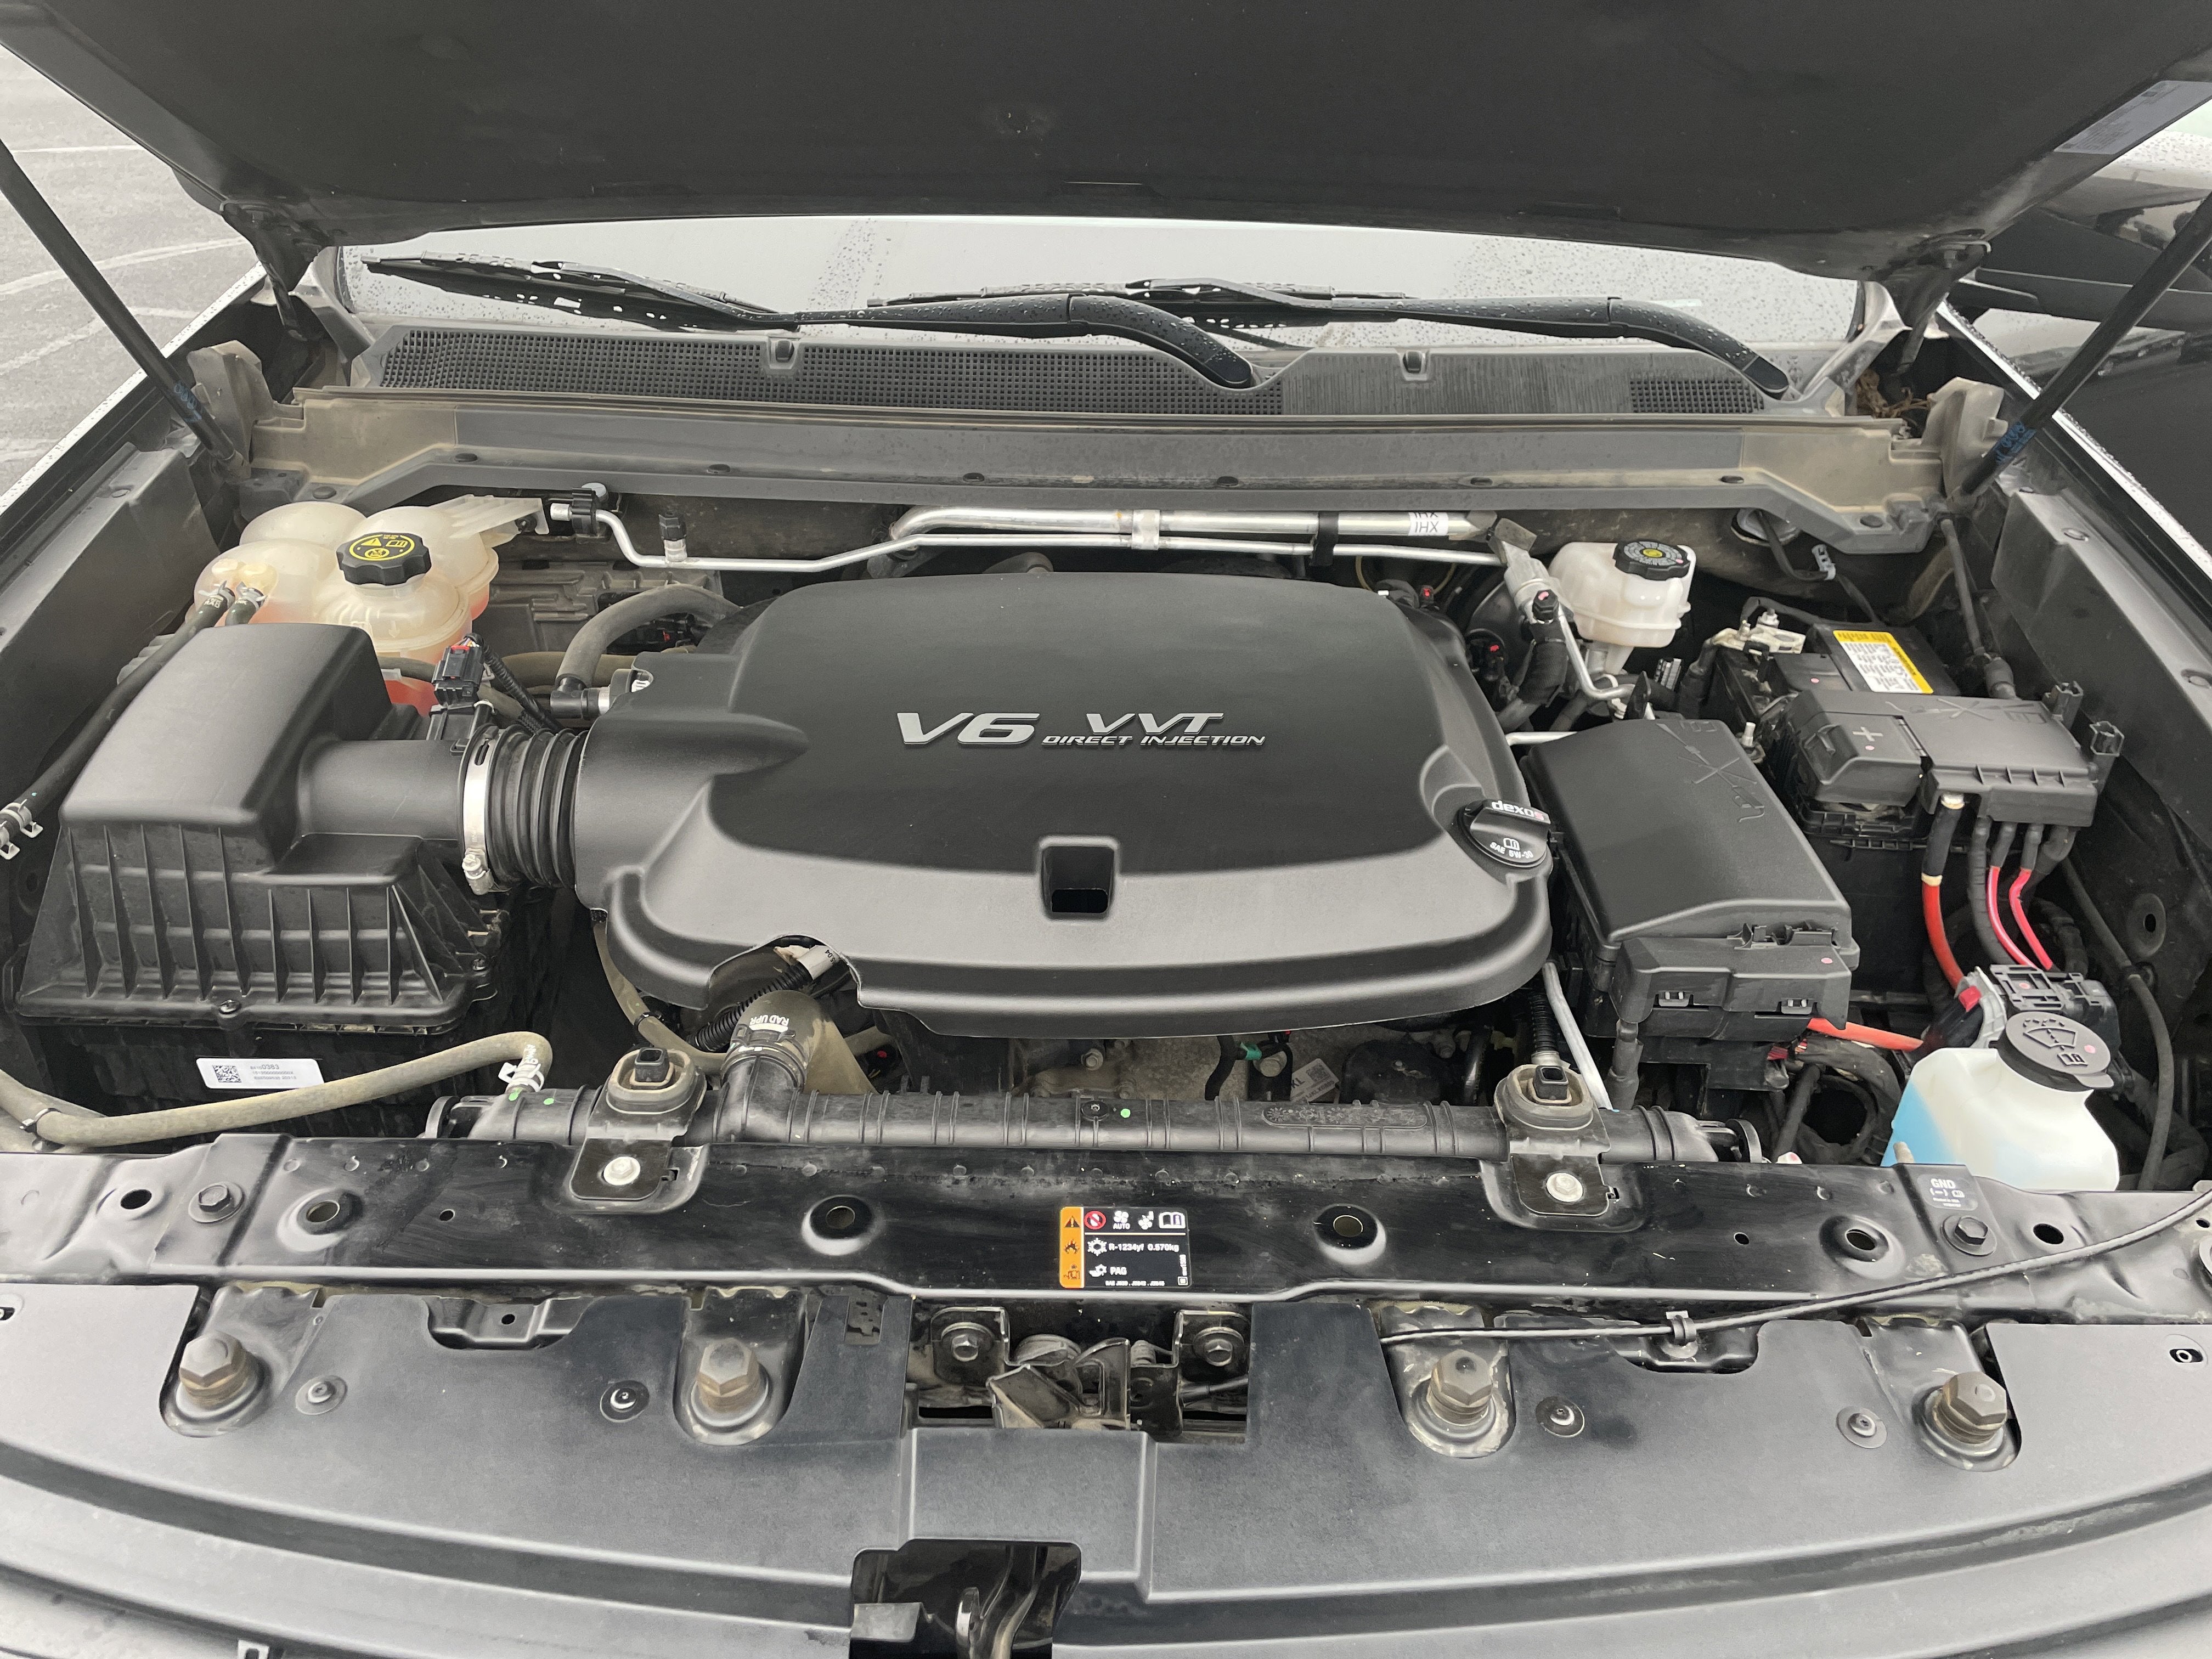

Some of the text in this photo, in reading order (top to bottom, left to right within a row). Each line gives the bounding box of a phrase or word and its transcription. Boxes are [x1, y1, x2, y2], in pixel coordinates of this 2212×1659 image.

[1415, 521, 1438, 533] IHX
[897, 713, 1224, 745] V6 VVT
[1042, 735, 1266, 746] DIRECT INJECTION
[1491, 800, 1544, 821] dexos
[1490, 842, 1505, 854] SAE
[749, 1015, 789, 1026] RAD UPR
[1930, 1178, 1956, 1189] GND
[1108, 1243, 1144, 1252] R-1234yf
[1110, 1266, 1127, 1276] PAG
